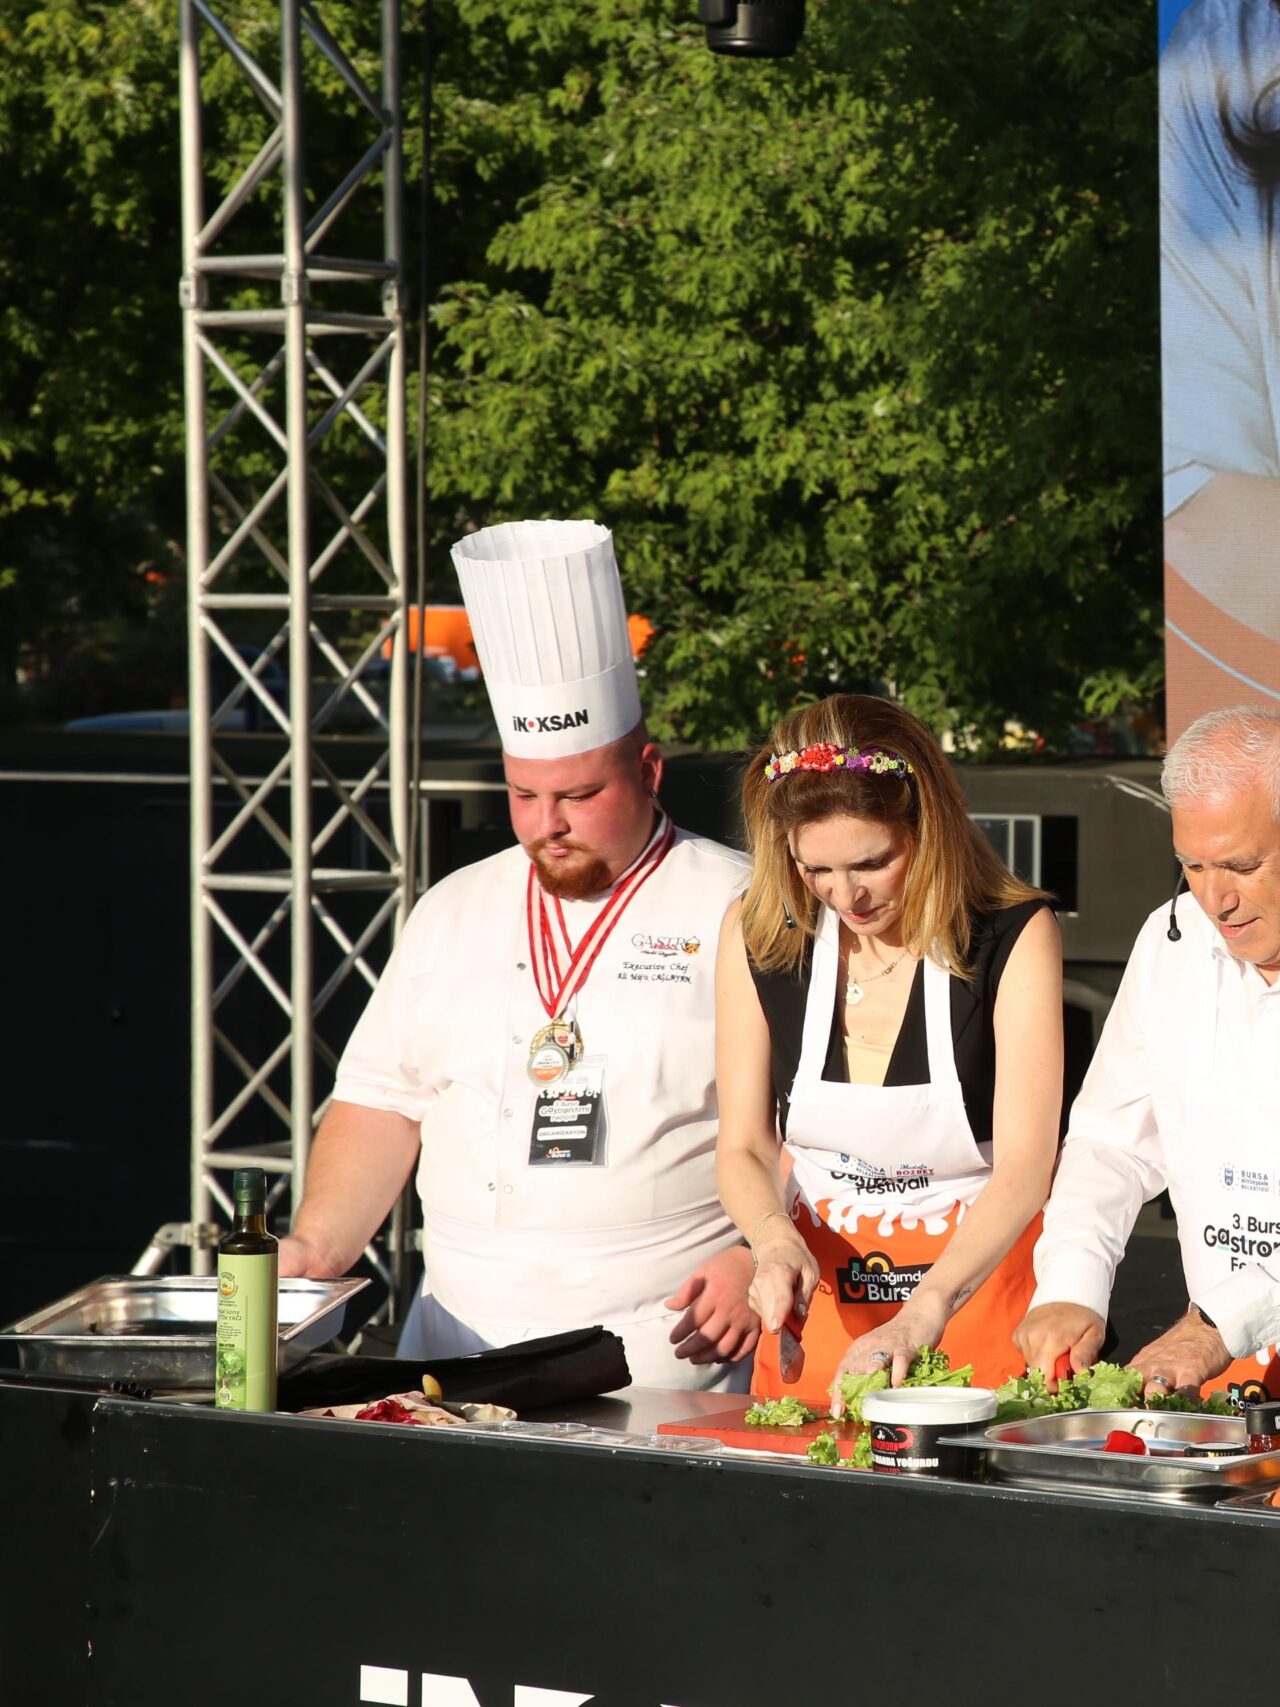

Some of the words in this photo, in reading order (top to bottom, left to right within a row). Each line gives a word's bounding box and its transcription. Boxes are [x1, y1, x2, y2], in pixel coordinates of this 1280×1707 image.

[669, 962, 690, 974] Chef
[896, 1168, 935, 1176] BOZBEY
[1241, 1170, 1269, 1181] BURSA
[1232, 1213, 1244, 1231] 3.
[896, 1456, 939, 1468] YOĞURDU
